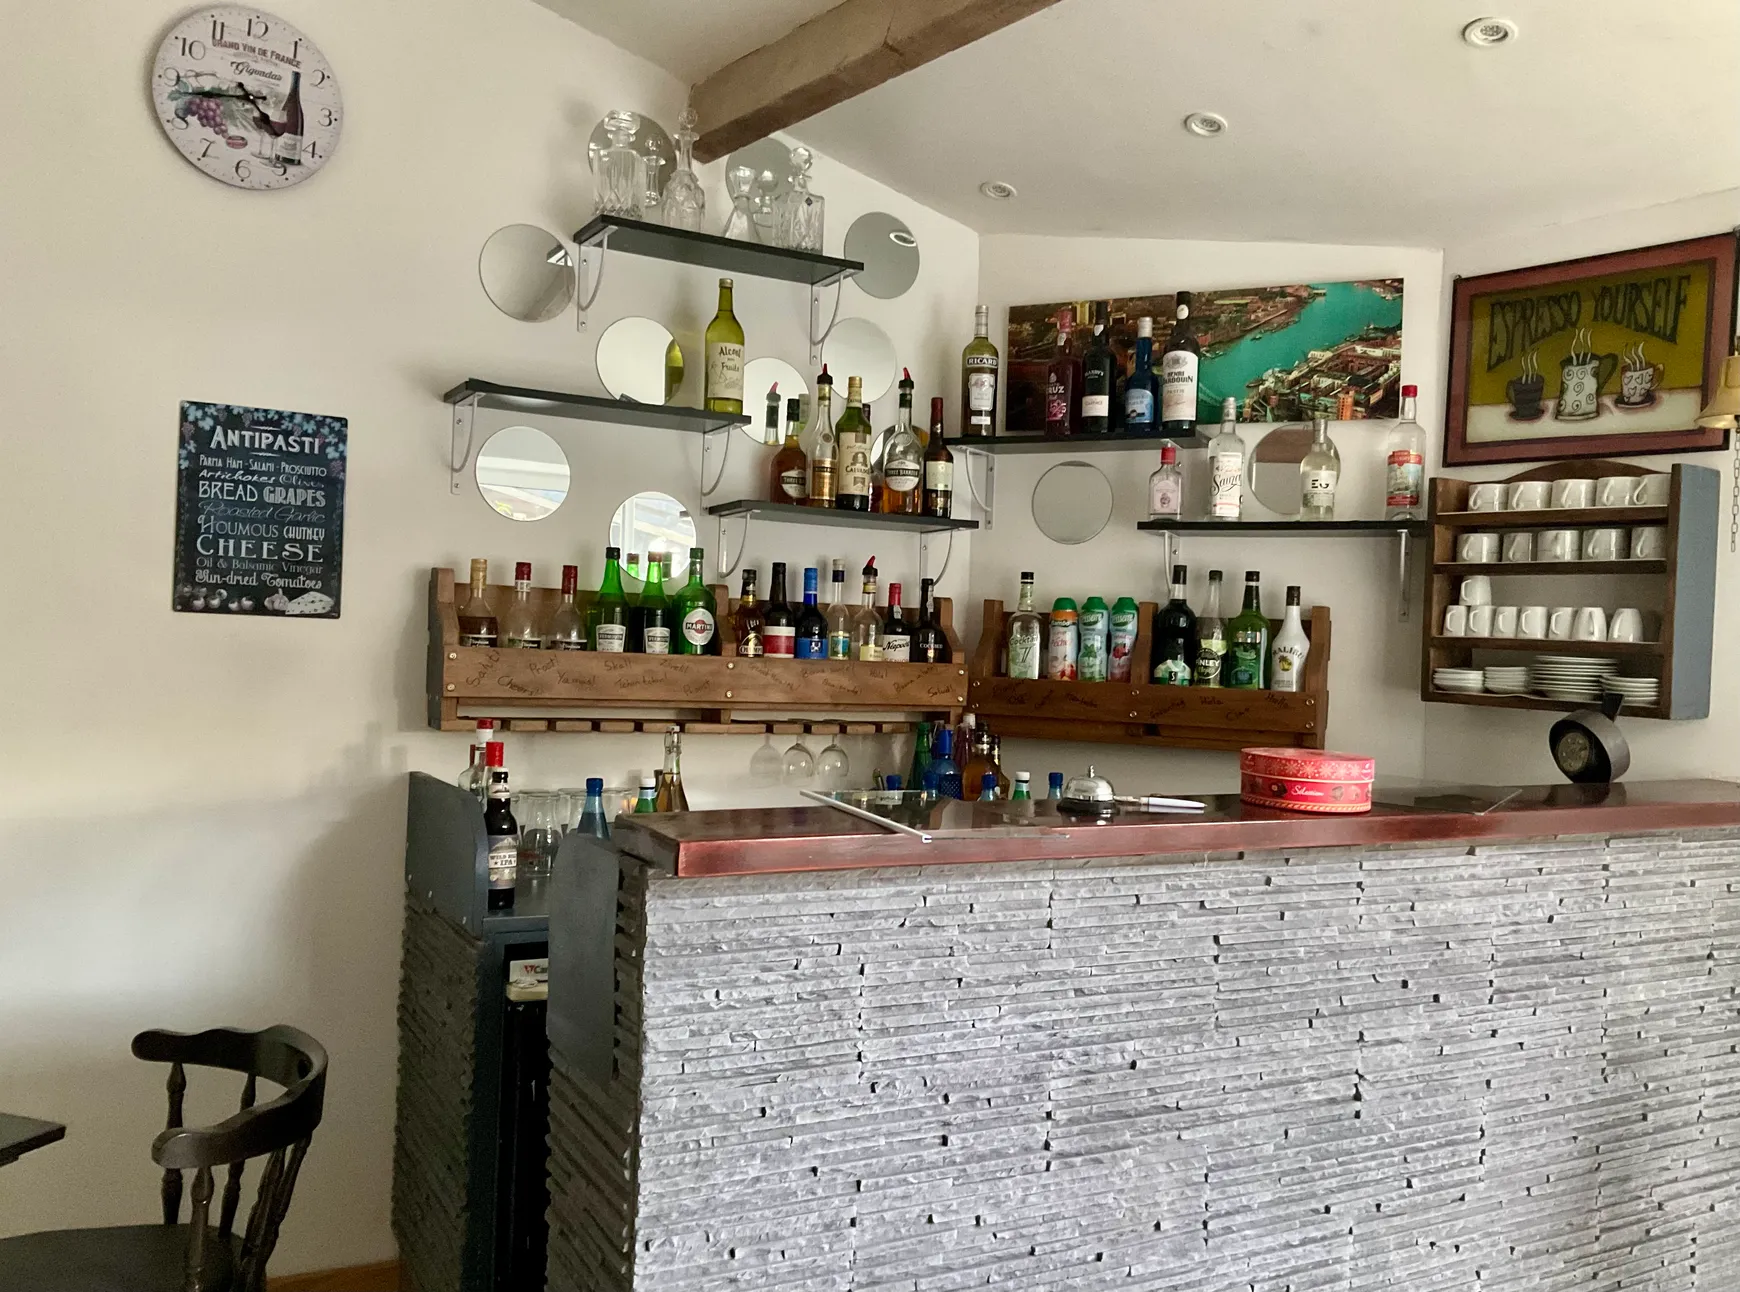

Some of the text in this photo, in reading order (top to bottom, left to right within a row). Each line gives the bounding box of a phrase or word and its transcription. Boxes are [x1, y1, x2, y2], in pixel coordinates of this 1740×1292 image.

[247, 18, 269, 41] 12
[181, 37, 206, 60] 10
[242, 42, 256, 55] VIN
[257, 47, 269, 58] DE
[270, 50, 302, 69] FRANCE
[293, 40, 299, 59] 1
[163, 67, 181, 87] 9
[309, 69, 326, 89] 2
[317, 107, 333, 128] 3
[200, 137, 216, 158] 7
[302, 140, 317, 159] 4
[234, 159, 251, 179] 6
[968, 356, 998, 367] RICARD
[199, 469, 276, 484] Artichokes
[198, 481, 327, 508] BREAD GRAPES
[198, 500, 326, 524] Roasted Garlic
[283, 525, 325, 541] CHUTNEY
[196, 534, 324, 563] CHEESE
[196, 556, 324, 575] Oil & Balsamic Vinegar
[195, 568, 322, 590] Sun-dried Tomatoes
[686, 622, 713, 631] MARTINI
